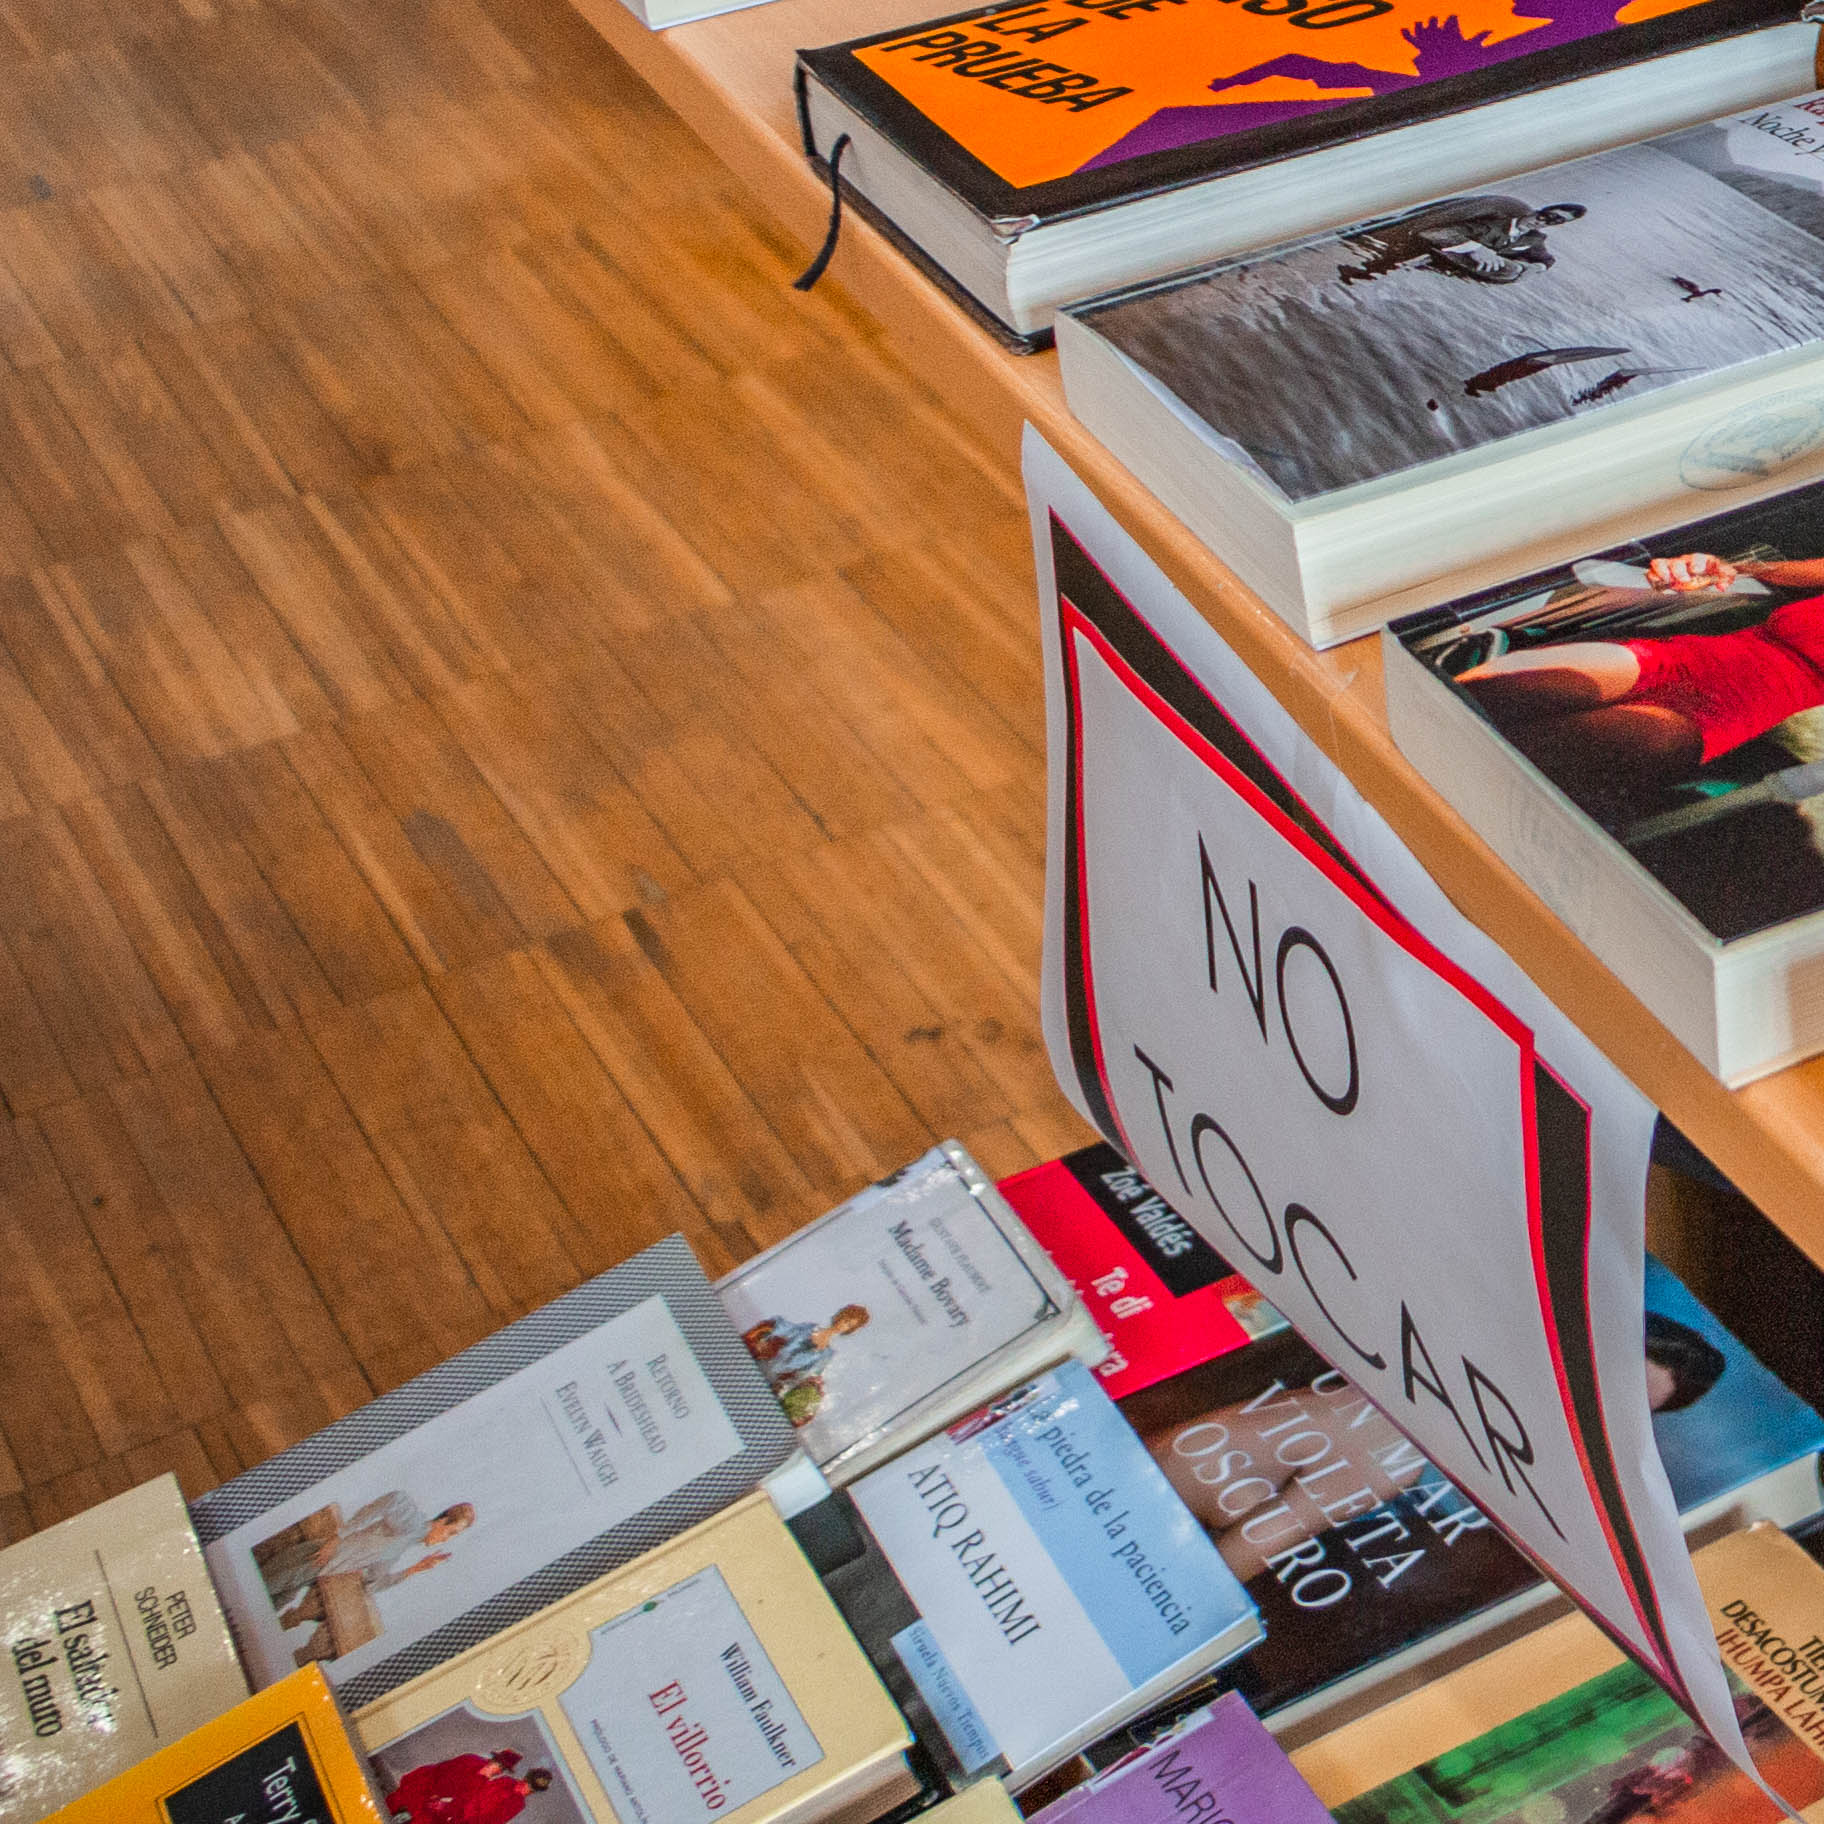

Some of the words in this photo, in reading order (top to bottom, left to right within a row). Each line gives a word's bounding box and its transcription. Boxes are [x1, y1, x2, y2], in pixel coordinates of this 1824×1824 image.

[971, 5, 1092, 45] LA
[880, 30, 1137, 114] PRUEBA
[1737, 109, 1819, 150] Noche
[1198, 828, 1361, 1117] NO
[1100, 1165, 1149, 1203] Zoé
[1129, 1195, 1195, 1259] Valdés
[887, 1218, 937, 1281] Madame
[929, 1276, 970, 1328] Bovary
[1090, 1265, 1131, 1298] Te
[1109, 1294, 1155, 1321] di
[1132, 1043, 1570, 1545] TOCAR
[607, 1358, 630, 1375] A
[645, 1352, 690, 1422] RETORNO
[553, 1380, 590, 1436] EVELYN
[581, 1422, 620, 1491] WAUGH
[614, 1370, 670, 1457] BRIDESHEAD
[1037, 1425, 1094, 1489] piedra
[1237, 1379, 1428, 1591] VIOLETA
[1085, 1487, 1115, 1517] de
[1103, 1509, 1131, 1541] la
[1172, 1422, 1352, 1611] OSCURO
[906, 1462, 968, 1540] ATIQ
[951, 1528, 1042, 1646] RAHIMI
[1111, 1539, 1194, 1637] paciencia
[54, 1599, 99, 1635] El
[133, 1585, 178, 1671] SCHNEIDER
[165, 1590, 197, 1640] PETER
[12, 1637, 60, 1676] del
[907, 1625, 941, 1680] Siruela
[22, 1674, 63, 1738] muro
[649, 1679, 689, 1717] El
[719, 1641, 758, 1704] William
[750, 1698, 797, 1769] Faulkner
[666, 1714, 732, 1812] villorrio
